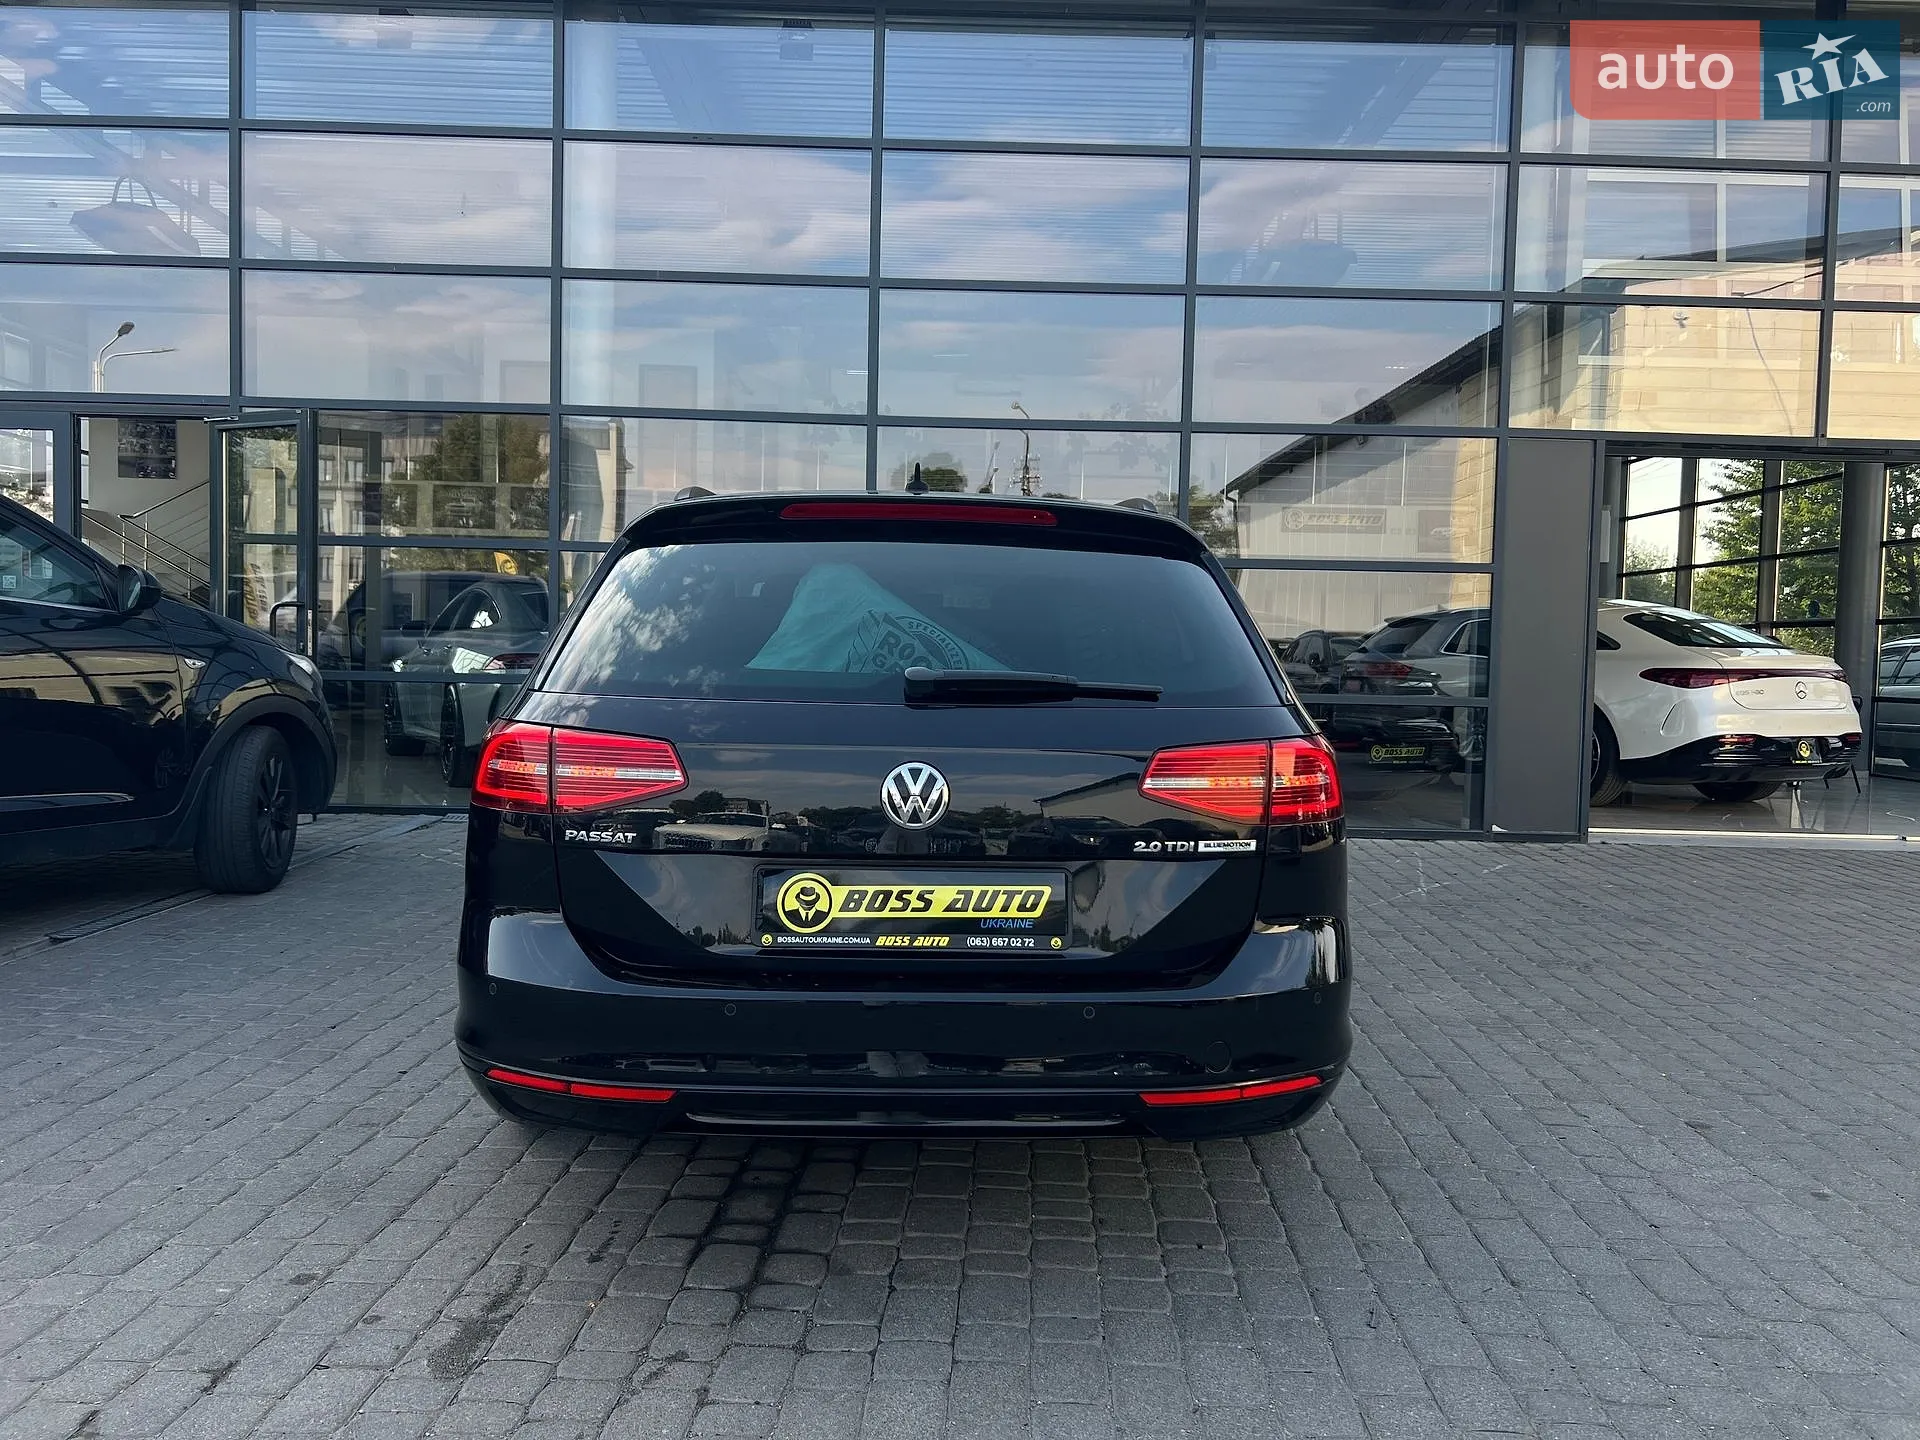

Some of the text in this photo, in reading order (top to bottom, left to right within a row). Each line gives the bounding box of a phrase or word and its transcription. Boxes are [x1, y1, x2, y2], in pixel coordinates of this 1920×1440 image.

[908, 620, 963, 670] SPECIALIZE
[565, 830, 637, 844] PASSAT
[1133, 840, 1195, 852] 2.0 TDI
[1203, 841, 1252, 849] BLUEMOTION
[838, 889, 1045, 913] BOSS AUTO
[980, 918, 1034, 929] UKRAINE
[777, 936, 871, 944] BOSSAUTOUKRAINE.COM.UA
[875, 936, 950, 946] BOSS AUTO
[966, 936, 1035, 948] (063) 667 02 72
